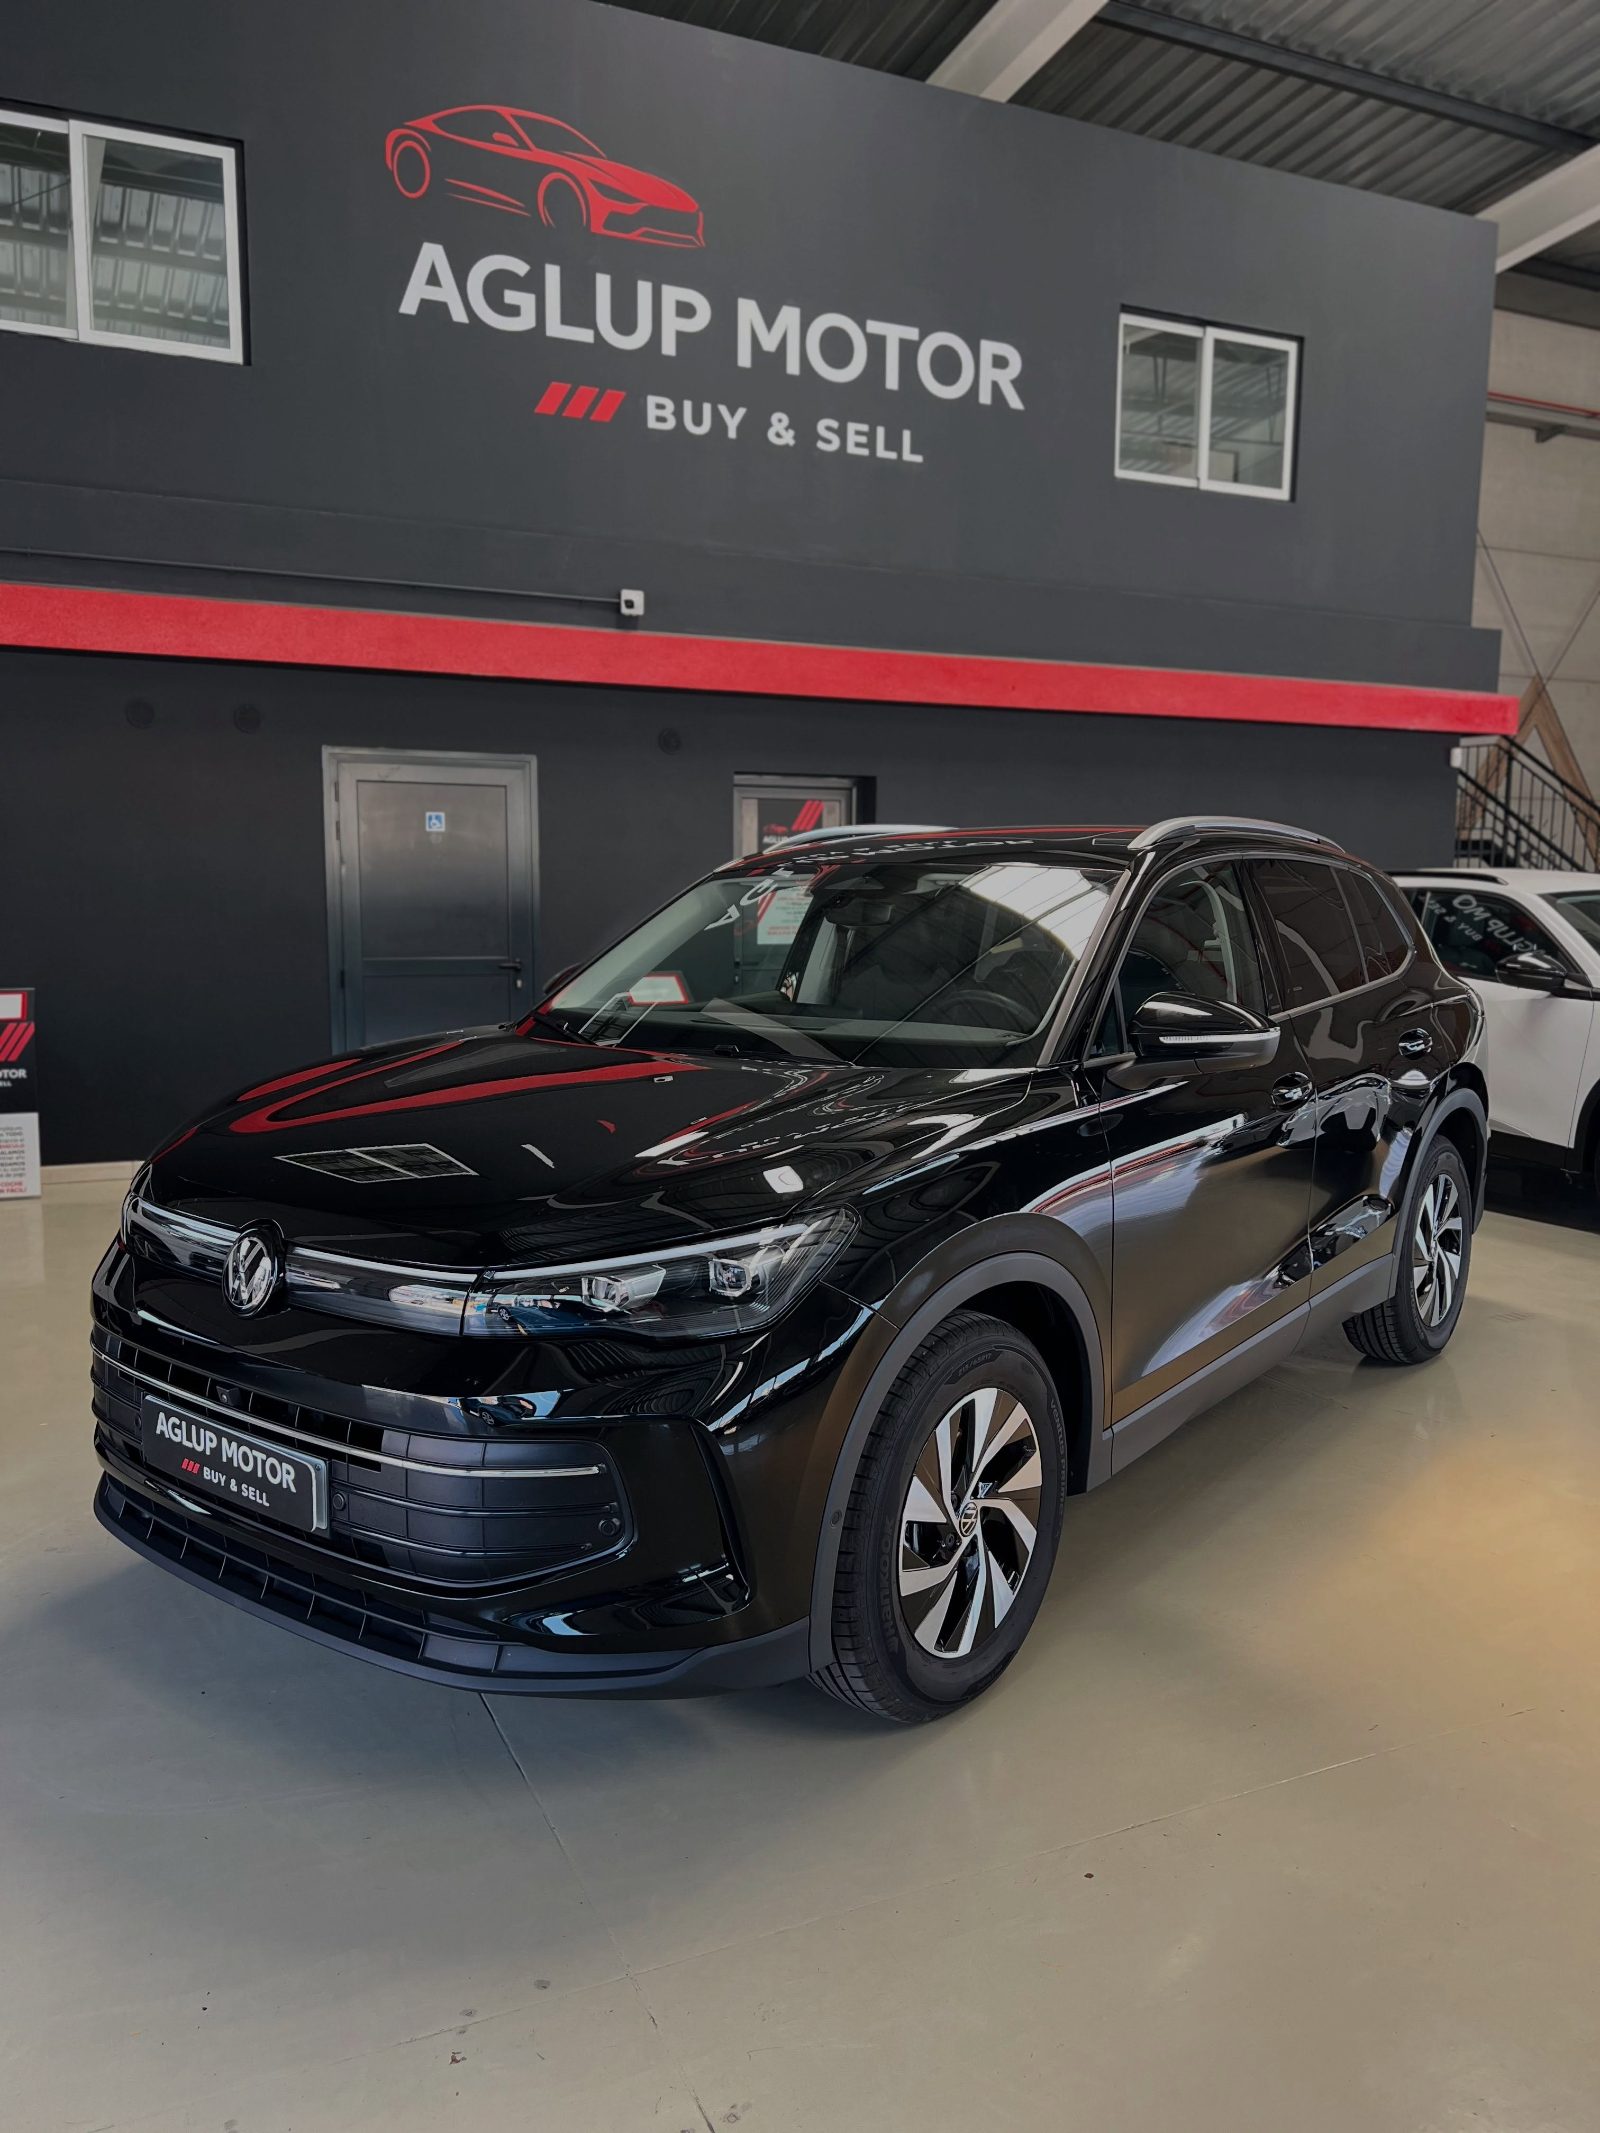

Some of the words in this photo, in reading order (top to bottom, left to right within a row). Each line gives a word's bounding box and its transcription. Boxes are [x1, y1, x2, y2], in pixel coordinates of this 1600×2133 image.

[398, 241, 711, 356] AGLUP
[736, 297, 1025, 411] MOTOR
[646, 394, 747, 440] BUY
[766, 412, 796, 446] &
[816, 418, 924, 464] SELL
[156, 1412, 217, 1455] AGLUP
[221, 1437, 296, 1492] MOTOR
[203, 1466, 227, 1487] BUY
[230, 1479, 238, 1492] &
[241, 1483, 270, 1507] SELL
